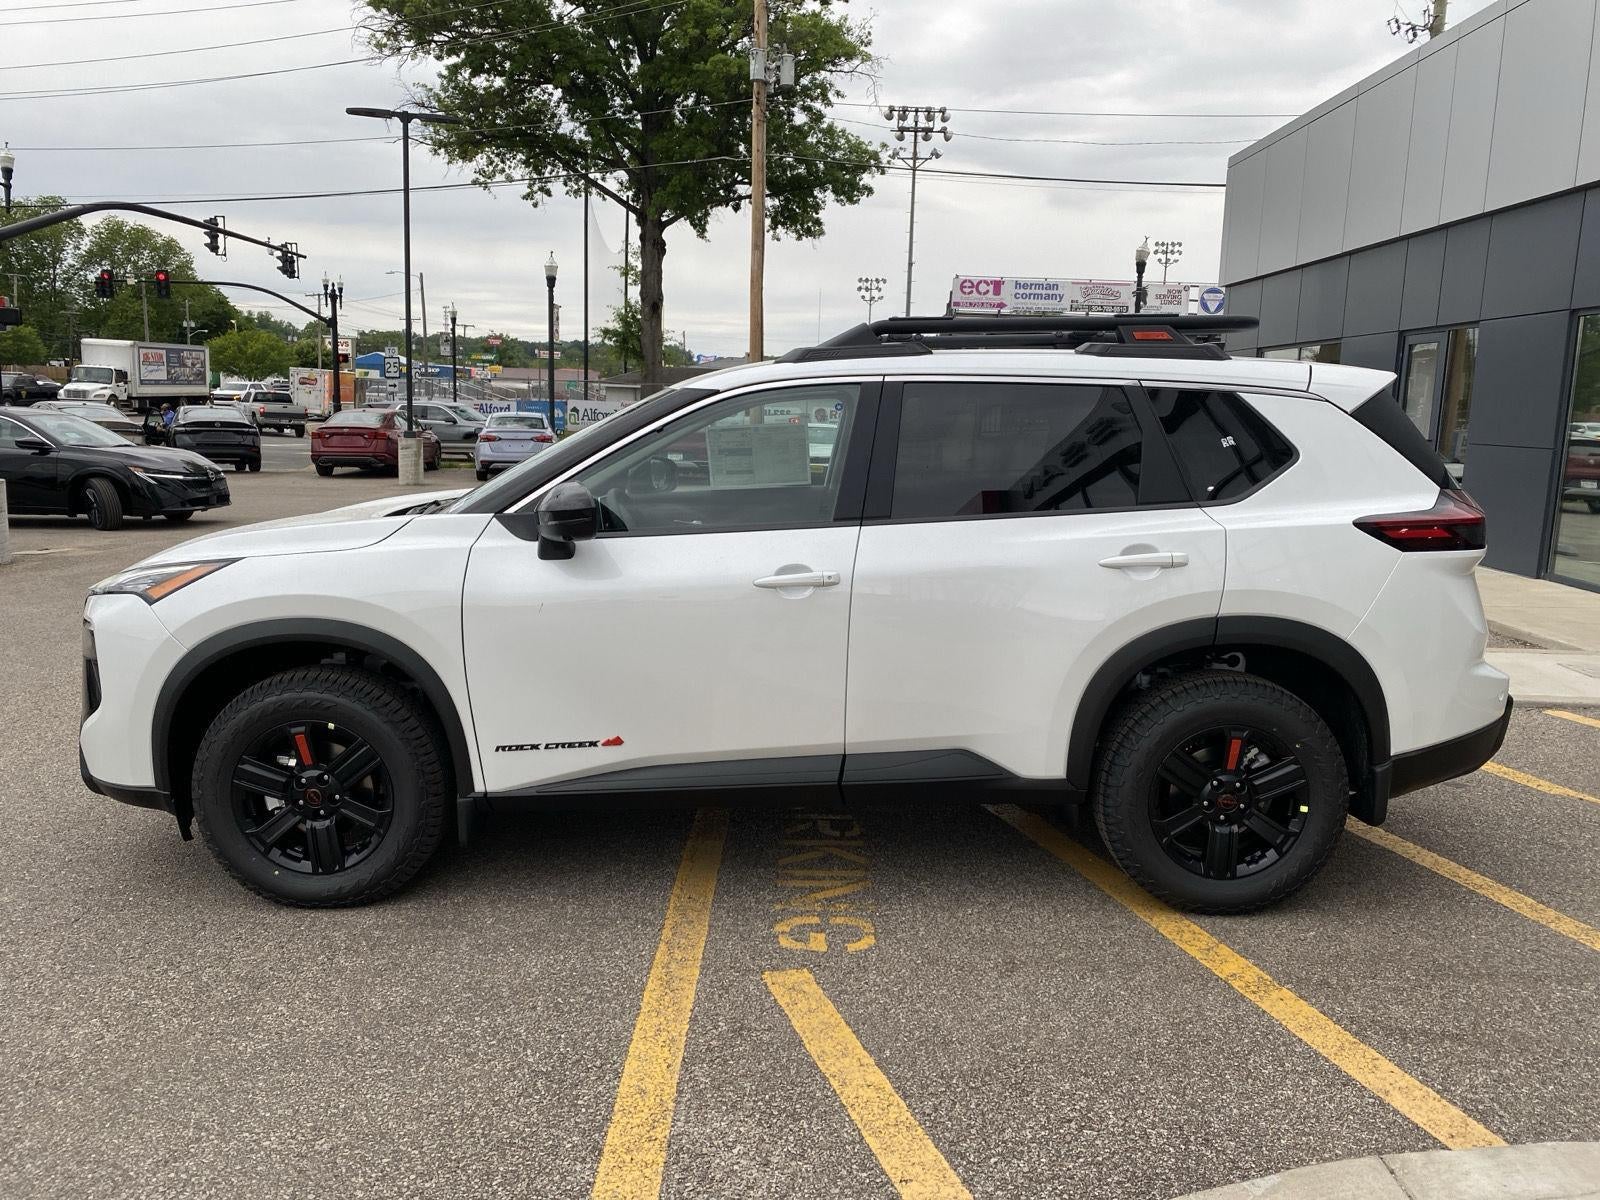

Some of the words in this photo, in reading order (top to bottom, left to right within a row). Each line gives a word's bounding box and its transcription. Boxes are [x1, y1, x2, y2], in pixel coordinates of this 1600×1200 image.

[1014, 280, 1059, 291] herman
[1013, 292, 1065, 303] cormany
[385, 361, 399, 374] 25
[479, 402, 511, 414] Alford
[494, 743, 542, 753] ROCK
[543, 740, 600, 750] CREEK
